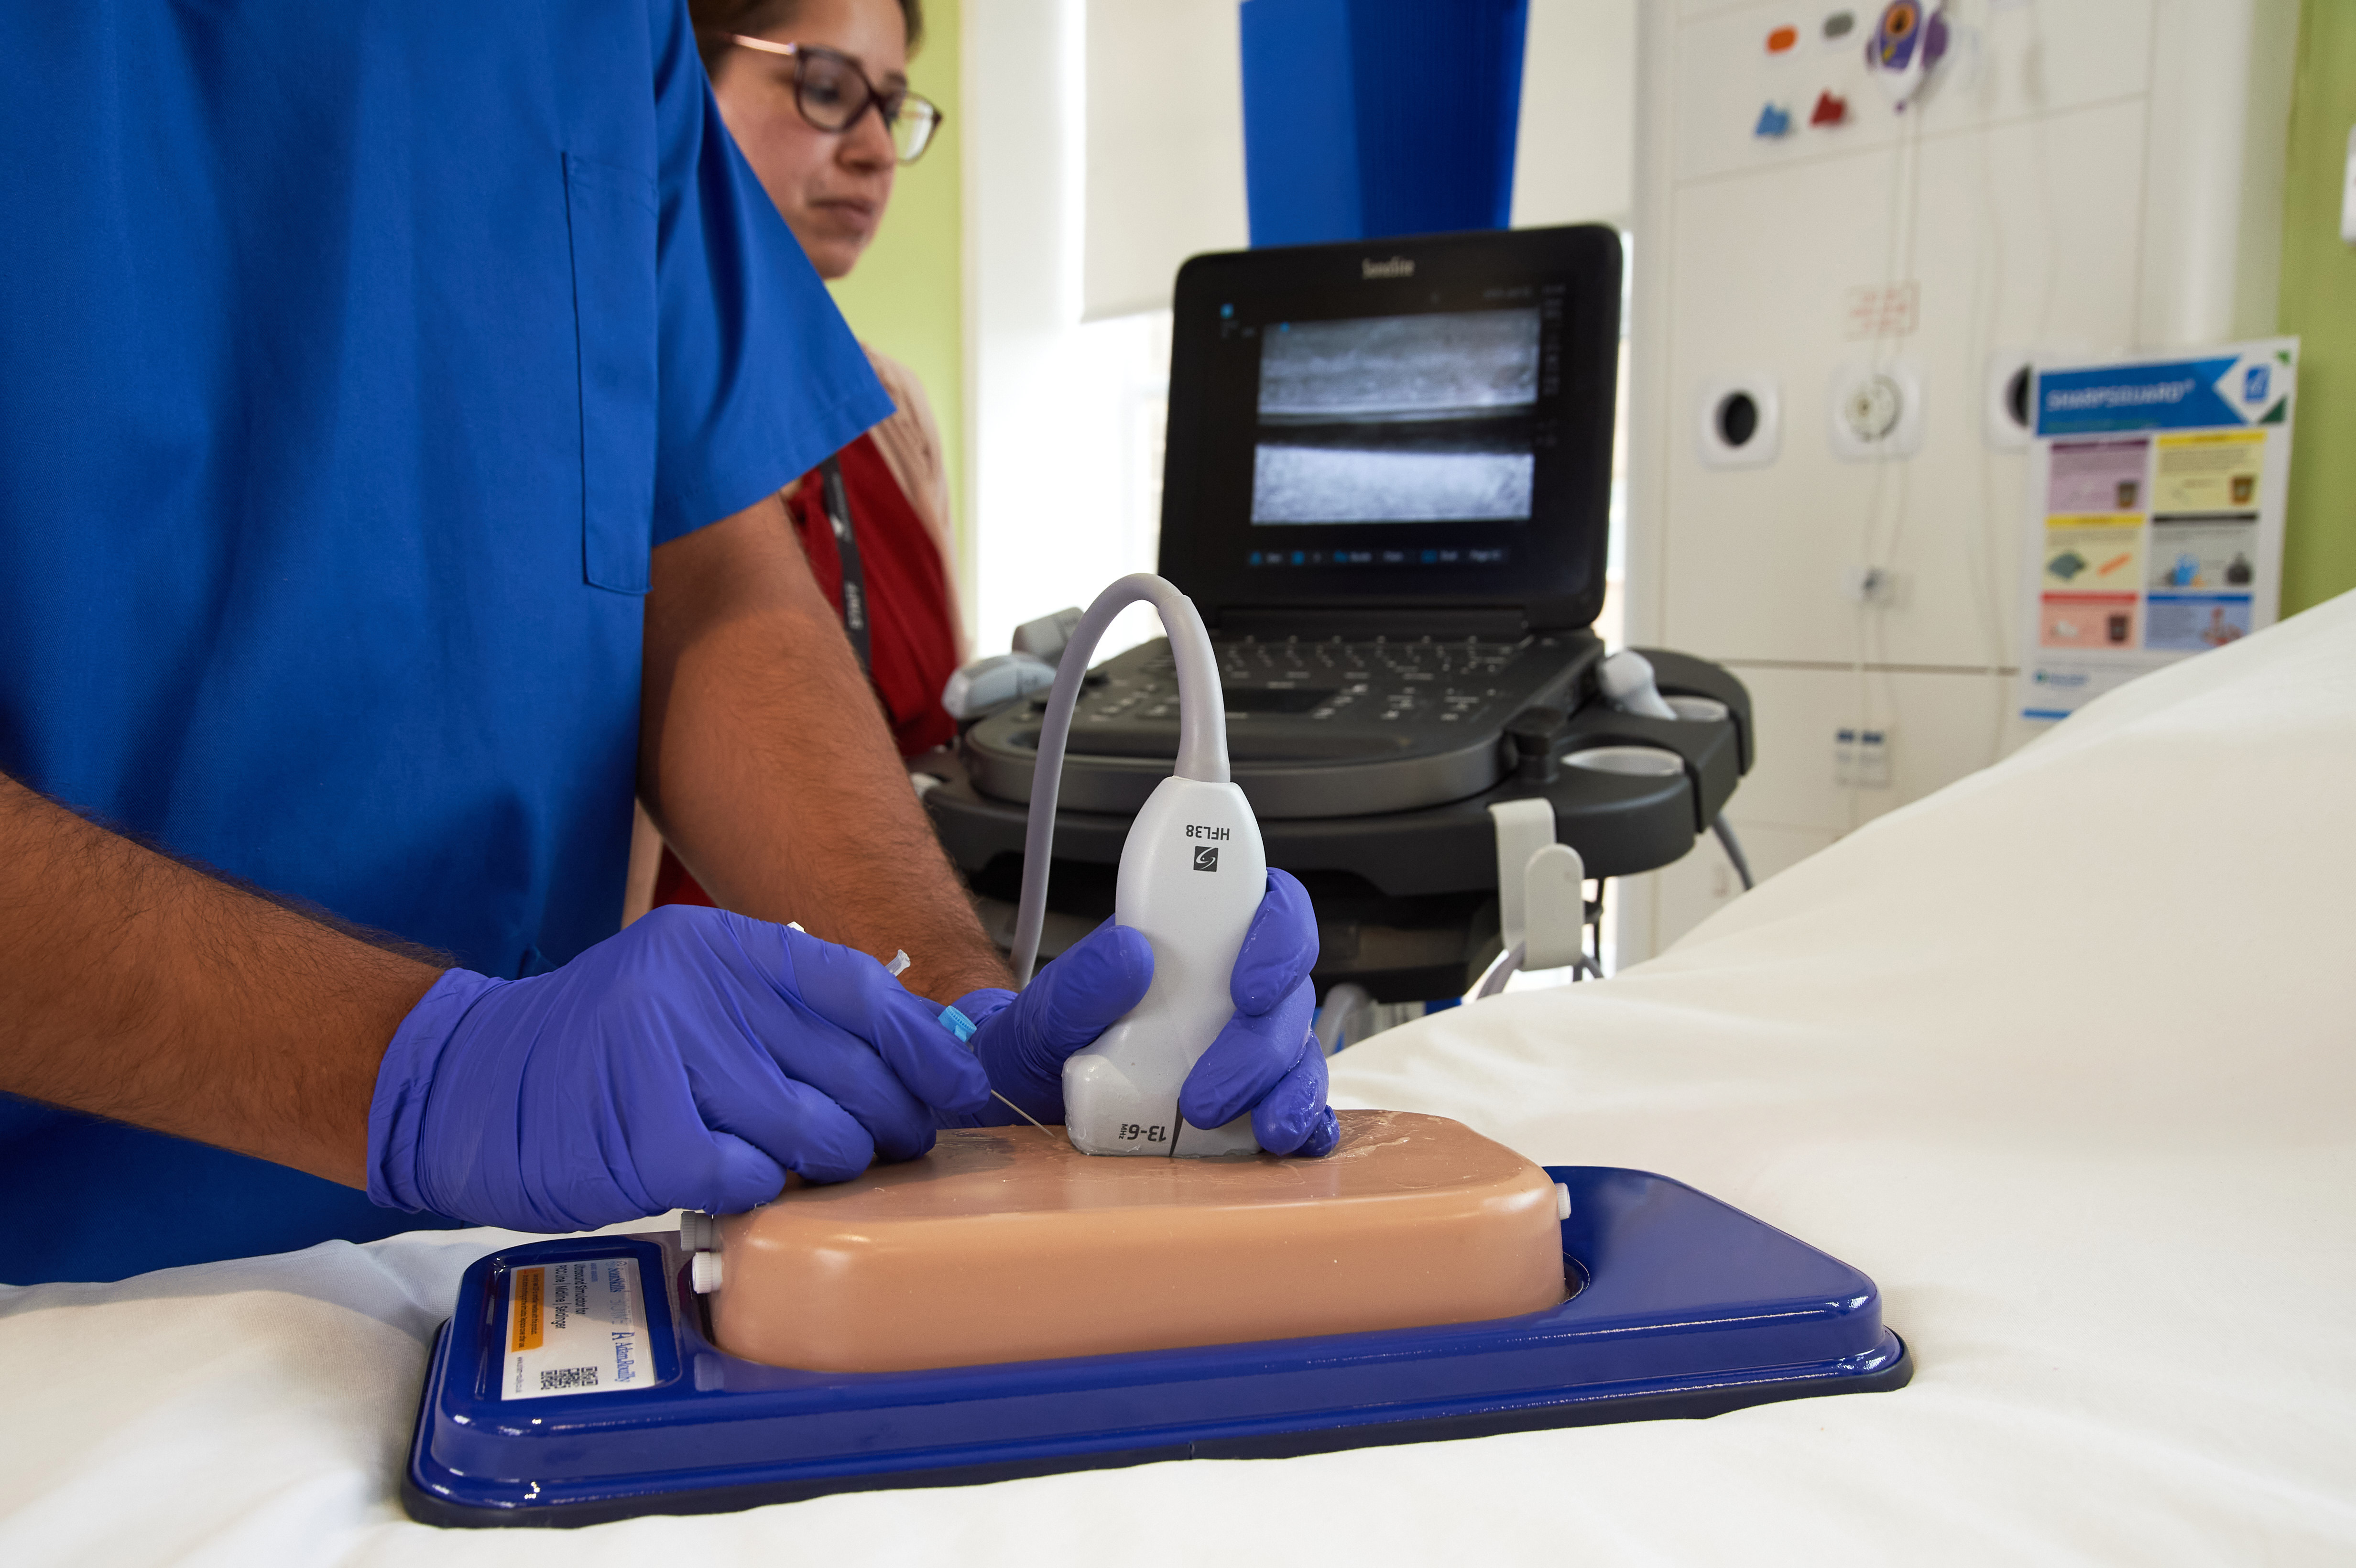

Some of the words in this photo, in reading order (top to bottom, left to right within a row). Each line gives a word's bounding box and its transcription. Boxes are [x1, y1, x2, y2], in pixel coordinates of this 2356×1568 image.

[1186, 825, 1230, 840] HFL38
[1119, 1124, 1128, 1139] MHz
[1127, 1124, 1166, 1142] 13-6
[555, 1265, 568, 1274] PICC
[574, 1263, 587, 1285] Ultrasound
[555, 1286, 569, 1302] Midline
[575, 1285, 588, 1307] Simulator
[551, 1306, 569, 1329] Seldinger
